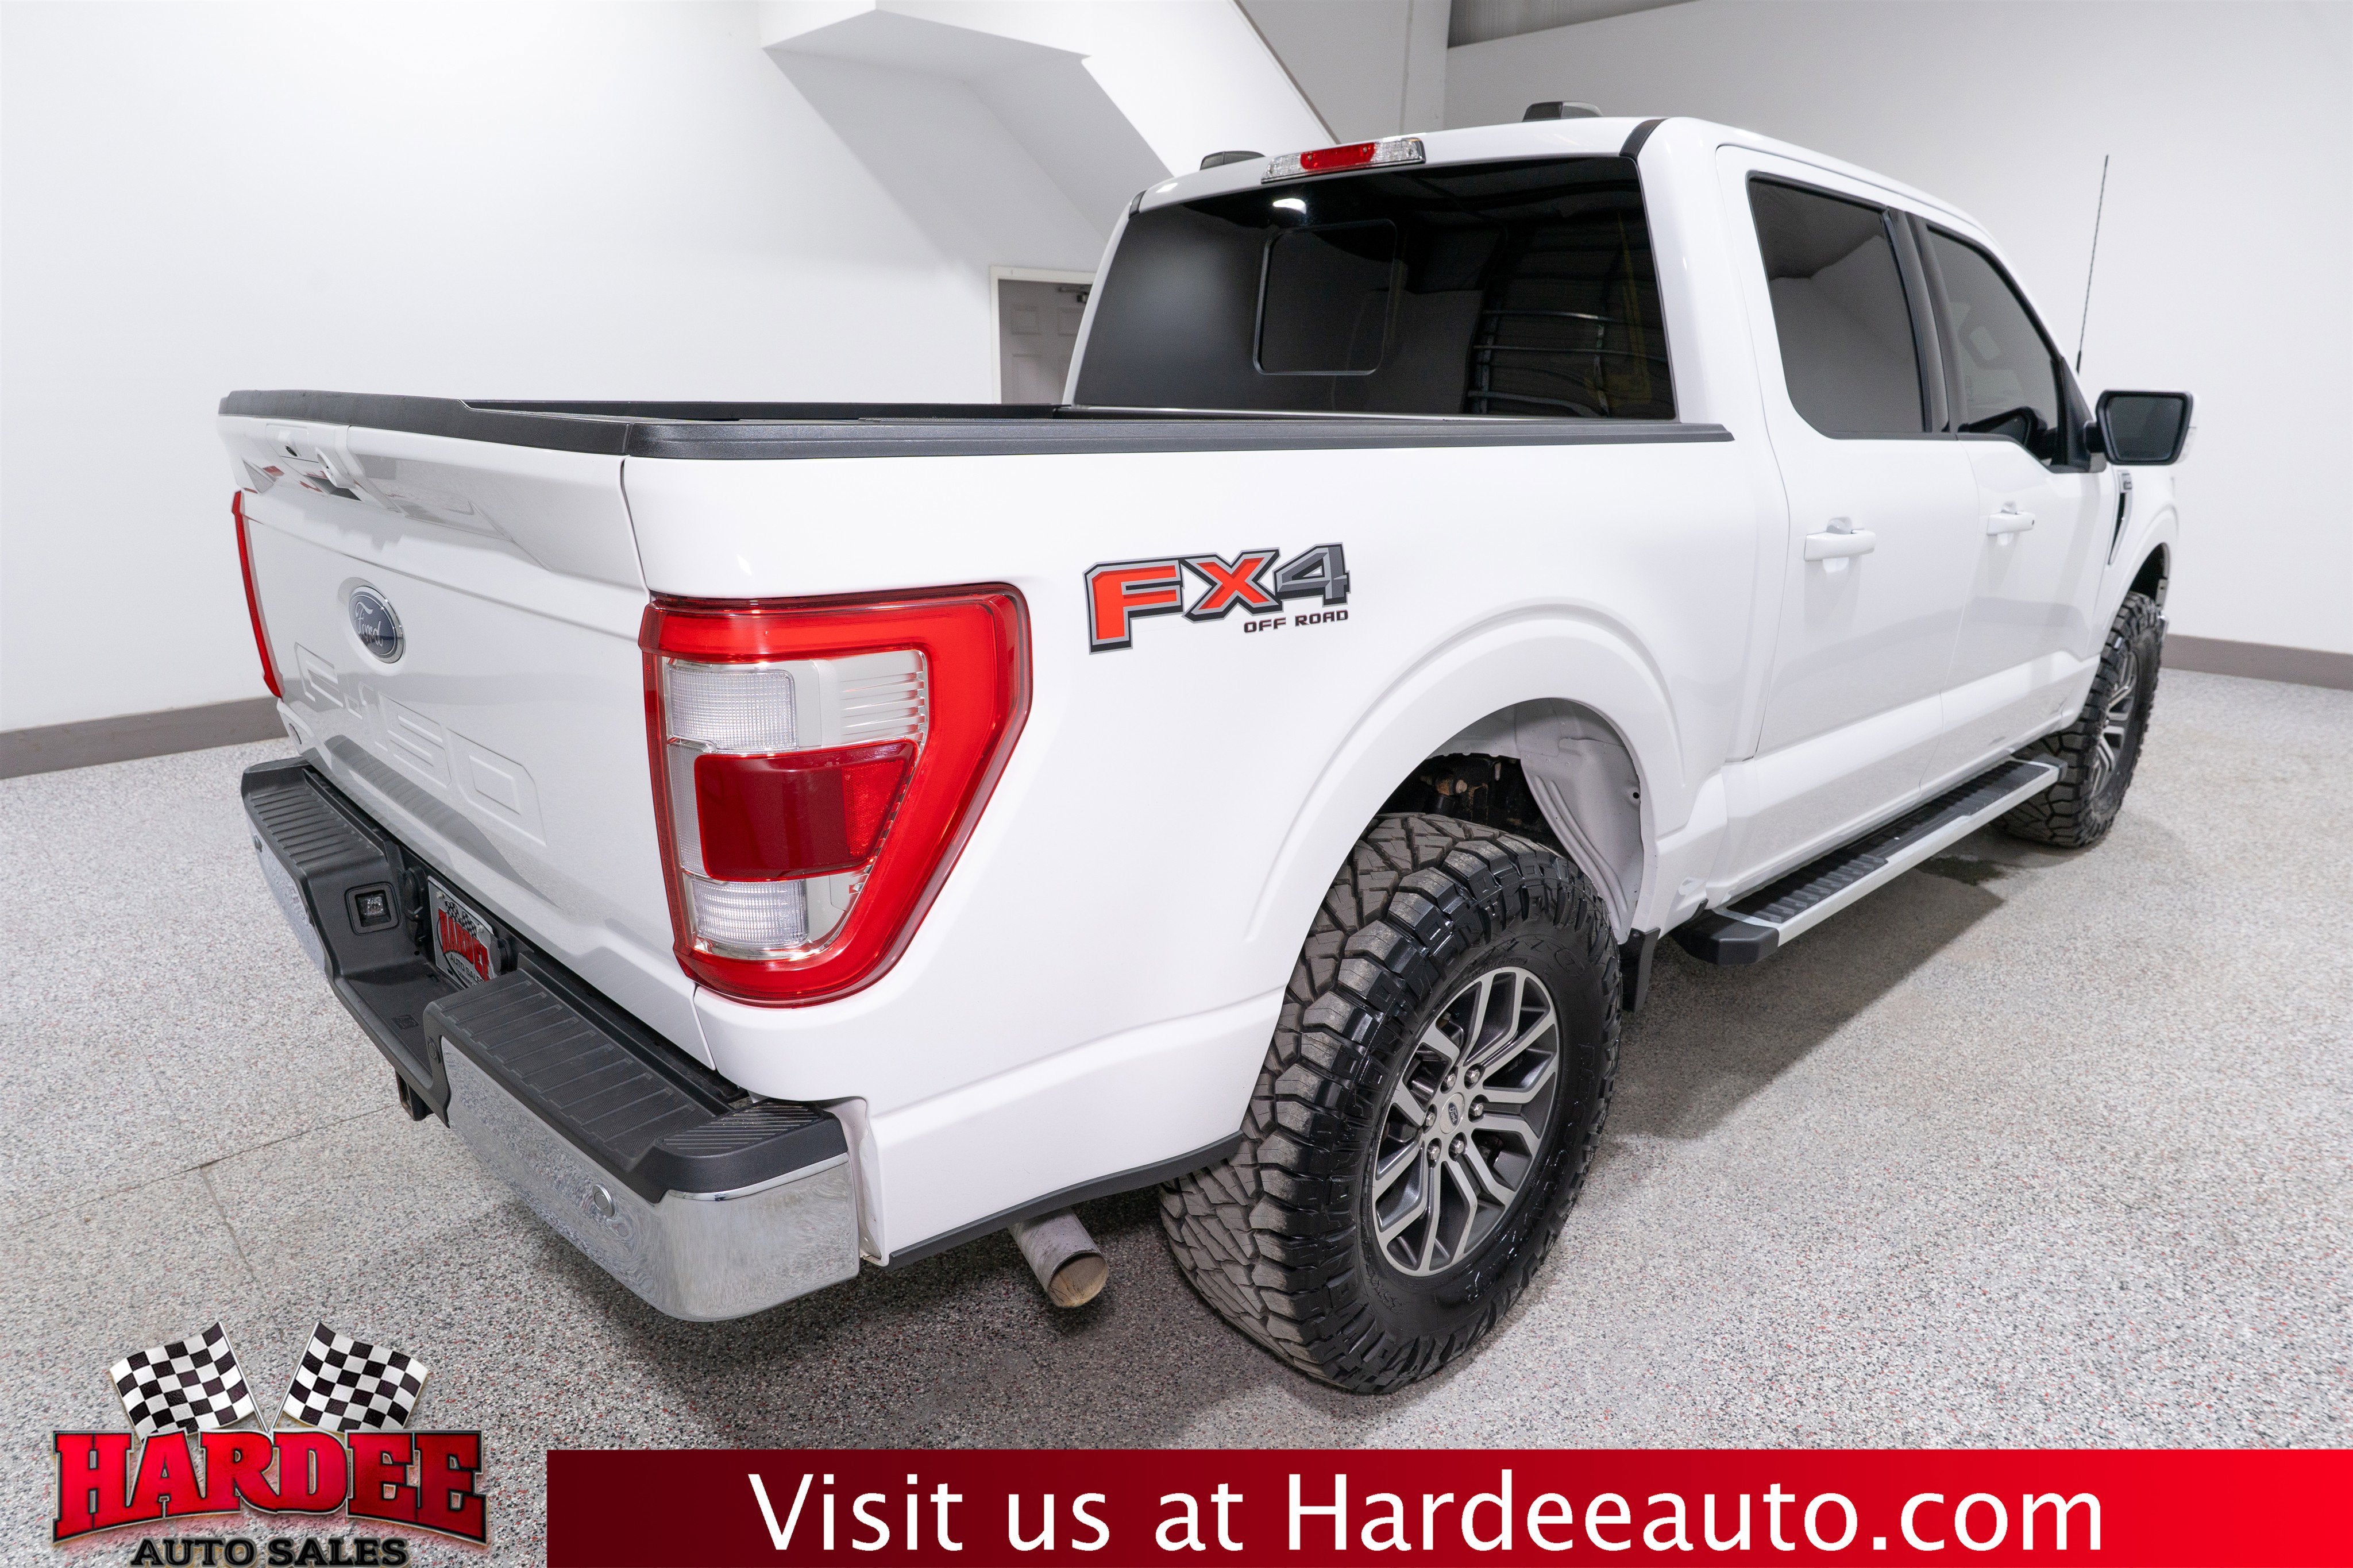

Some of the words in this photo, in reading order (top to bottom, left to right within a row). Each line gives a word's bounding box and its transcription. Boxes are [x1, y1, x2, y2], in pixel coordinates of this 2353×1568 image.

[1083, 542, 1351, 655] FX4
[1244, 617, 1286, 634] OFF
[1295, 609, 1348, 627] ROAD
[354, 601, 383, 647] Ford
[438, 908, 491, 982] HARDEE
[450, 953, 465, 972] AUTO
